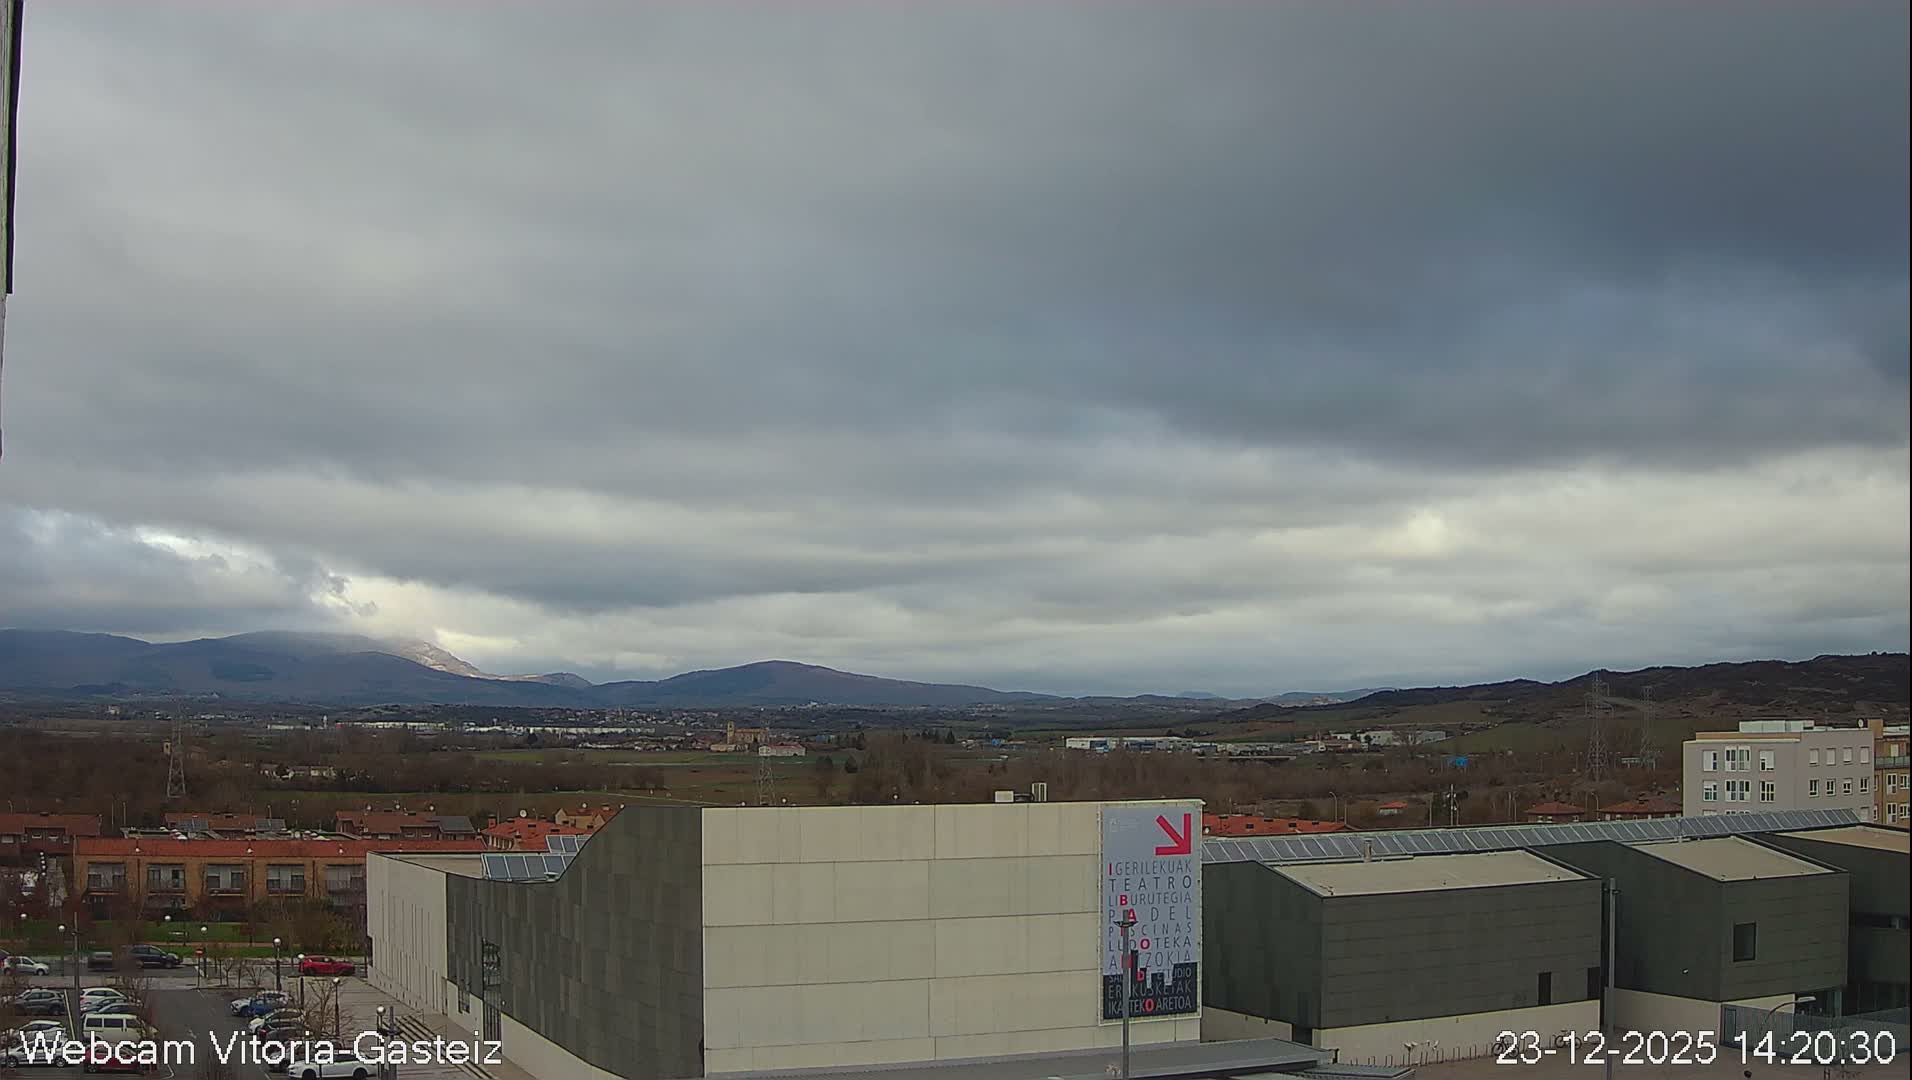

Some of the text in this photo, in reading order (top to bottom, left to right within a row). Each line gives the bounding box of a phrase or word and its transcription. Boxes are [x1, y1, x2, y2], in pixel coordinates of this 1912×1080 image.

[1109, 860, 1192, 876] IGERILEKUAK
[1109, 875, 1192, 892] TEATRO
[1109, 891, 1192, 907] LIBURUTEGIA
[1109, 906, 1192, 923] PADEL
[1109, 936, 1192, 952] LUDOTEKA
[1109, 950, 1192, 970] AZOKIA
[1157, 967, 1192, 979] ETUDIO
[1108, 980, 1192, 999] ERKUSKETAK
[1108, 996, 1192, 1015] IKATEKO ARETOA
